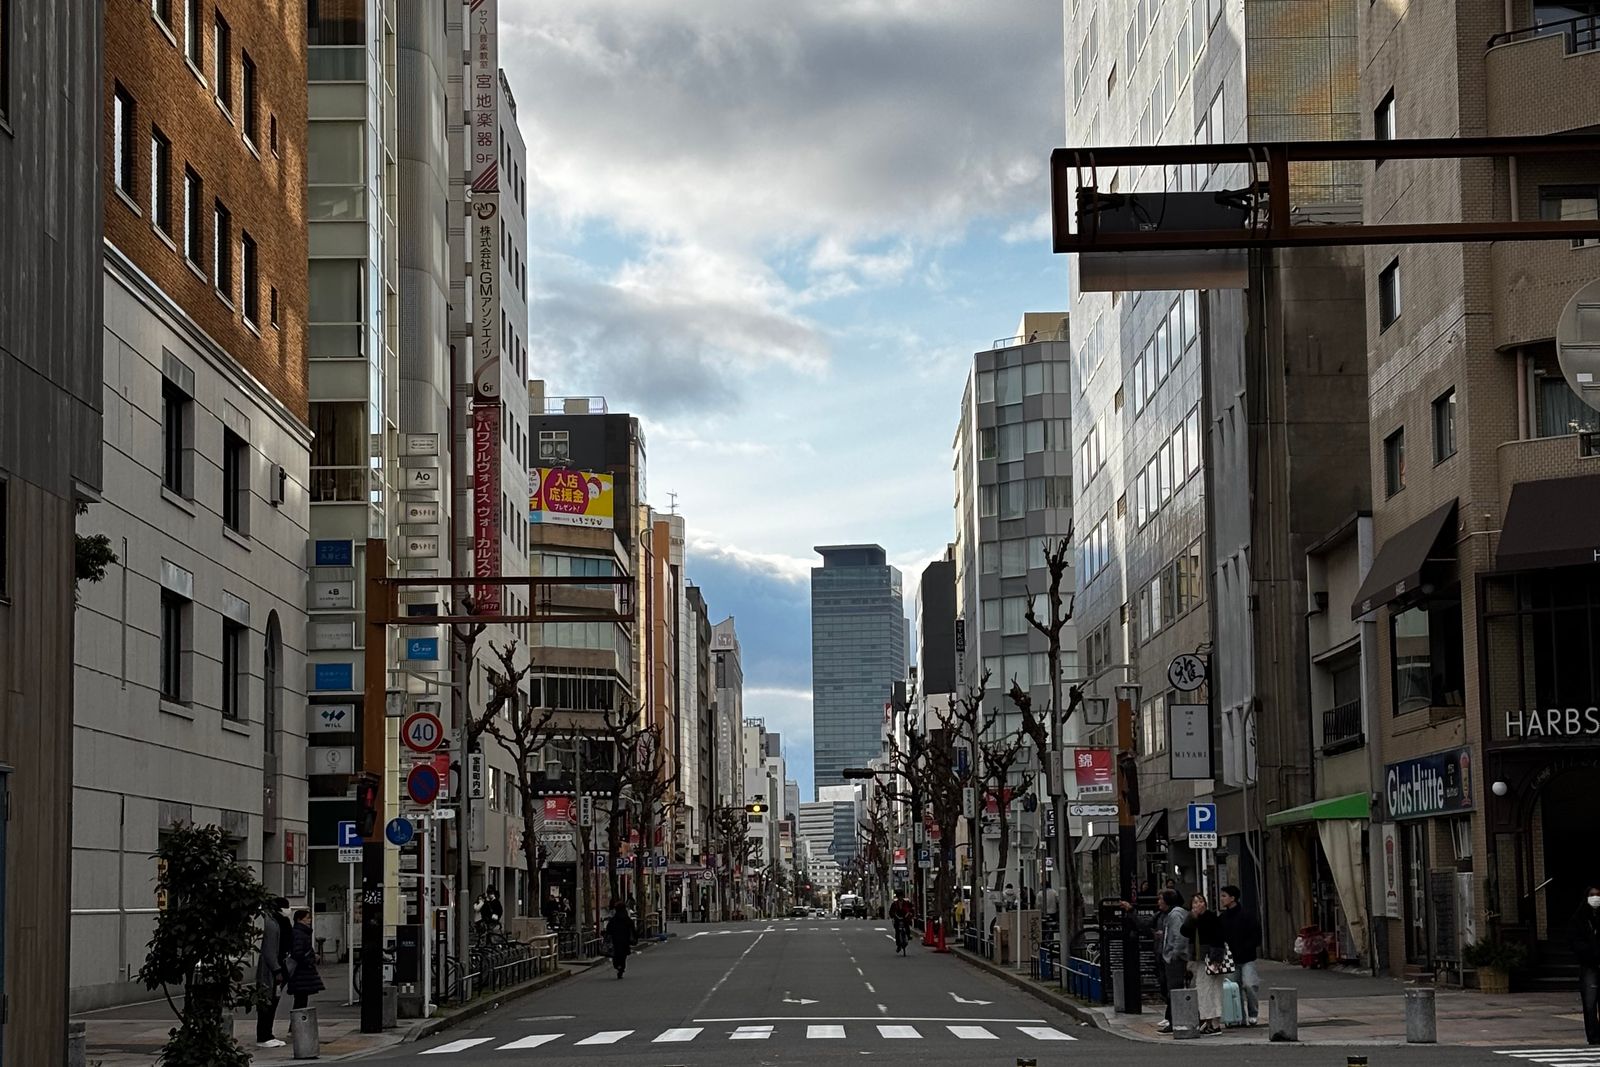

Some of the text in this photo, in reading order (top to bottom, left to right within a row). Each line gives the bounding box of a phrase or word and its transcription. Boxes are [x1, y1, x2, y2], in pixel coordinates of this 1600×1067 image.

[478, 9, 489, 70] ヤマハ音楽教室
[475, 73, 493, 148] 宮地楽器
[475, 153, 493, 164] 9F
[479, 225, 493, 359] 株式会社GMアソシエイツ
[482, 382, 494, 393] 6F
[476, 420, 492, 504] パワフルヴォイス
[415, 471, 431, 481] Ao
[554, 474, 579, 488] 入店
[549, 487, 584, 504] 応援金
[1174, 657, 1202, 683] 雅
[412, 723, 434, 741] 40
[1505, 707, 1600, 737] HARBS
[1194, 806, 1211, 829] P
[345, 823, 359, 845] P
